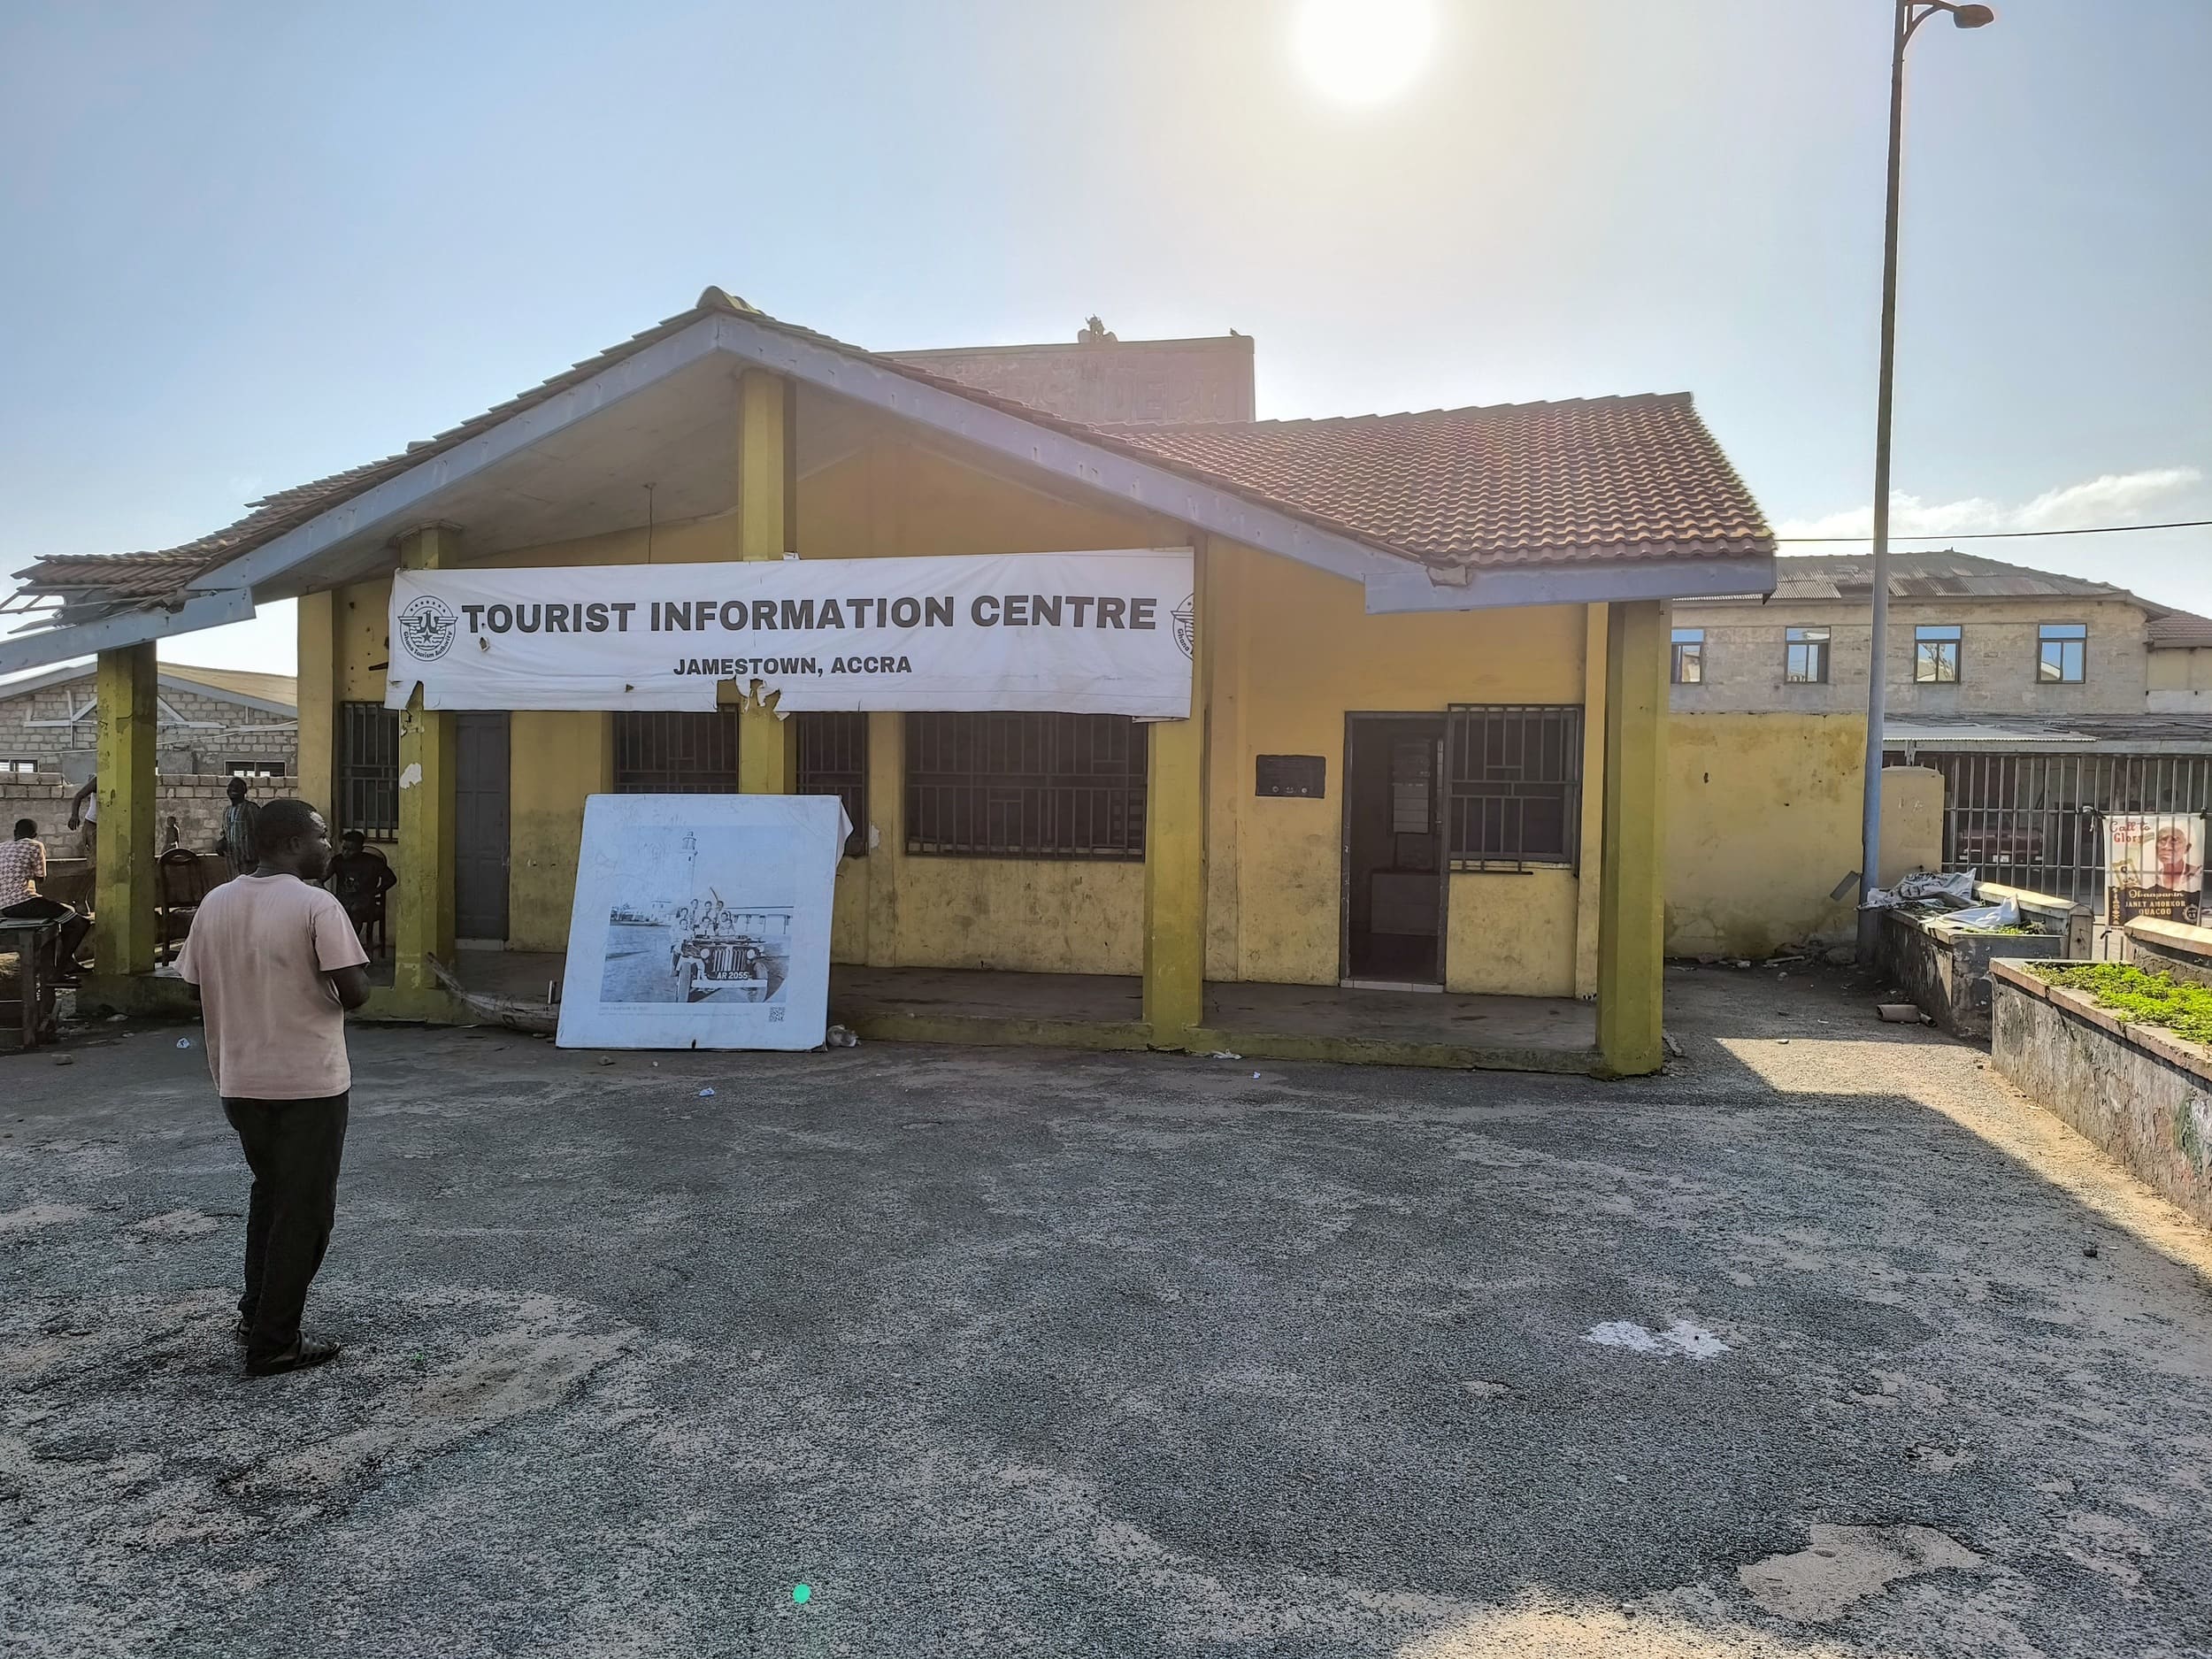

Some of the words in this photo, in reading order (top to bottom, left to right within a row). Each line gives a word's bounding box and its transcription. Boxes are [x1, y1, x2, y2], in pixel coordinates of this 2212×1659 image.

[461, 603, 636, 634] TOURIST
[650, 596, 955, 632] INFORMATION
[971, 595, 1157, 630] CENTRE
[403, 631, 415, 652] Ghana
[413, 649, 434, 658] Tourism
[434, 631, 453, 655] Authority
[1177, 628, 1190, 651] Ghana
[672, 657, 824, 678] JAMESTOWN,
[830, 657, 912, 673] ACCRA
[2114, 832, 2144, 844] Glory
